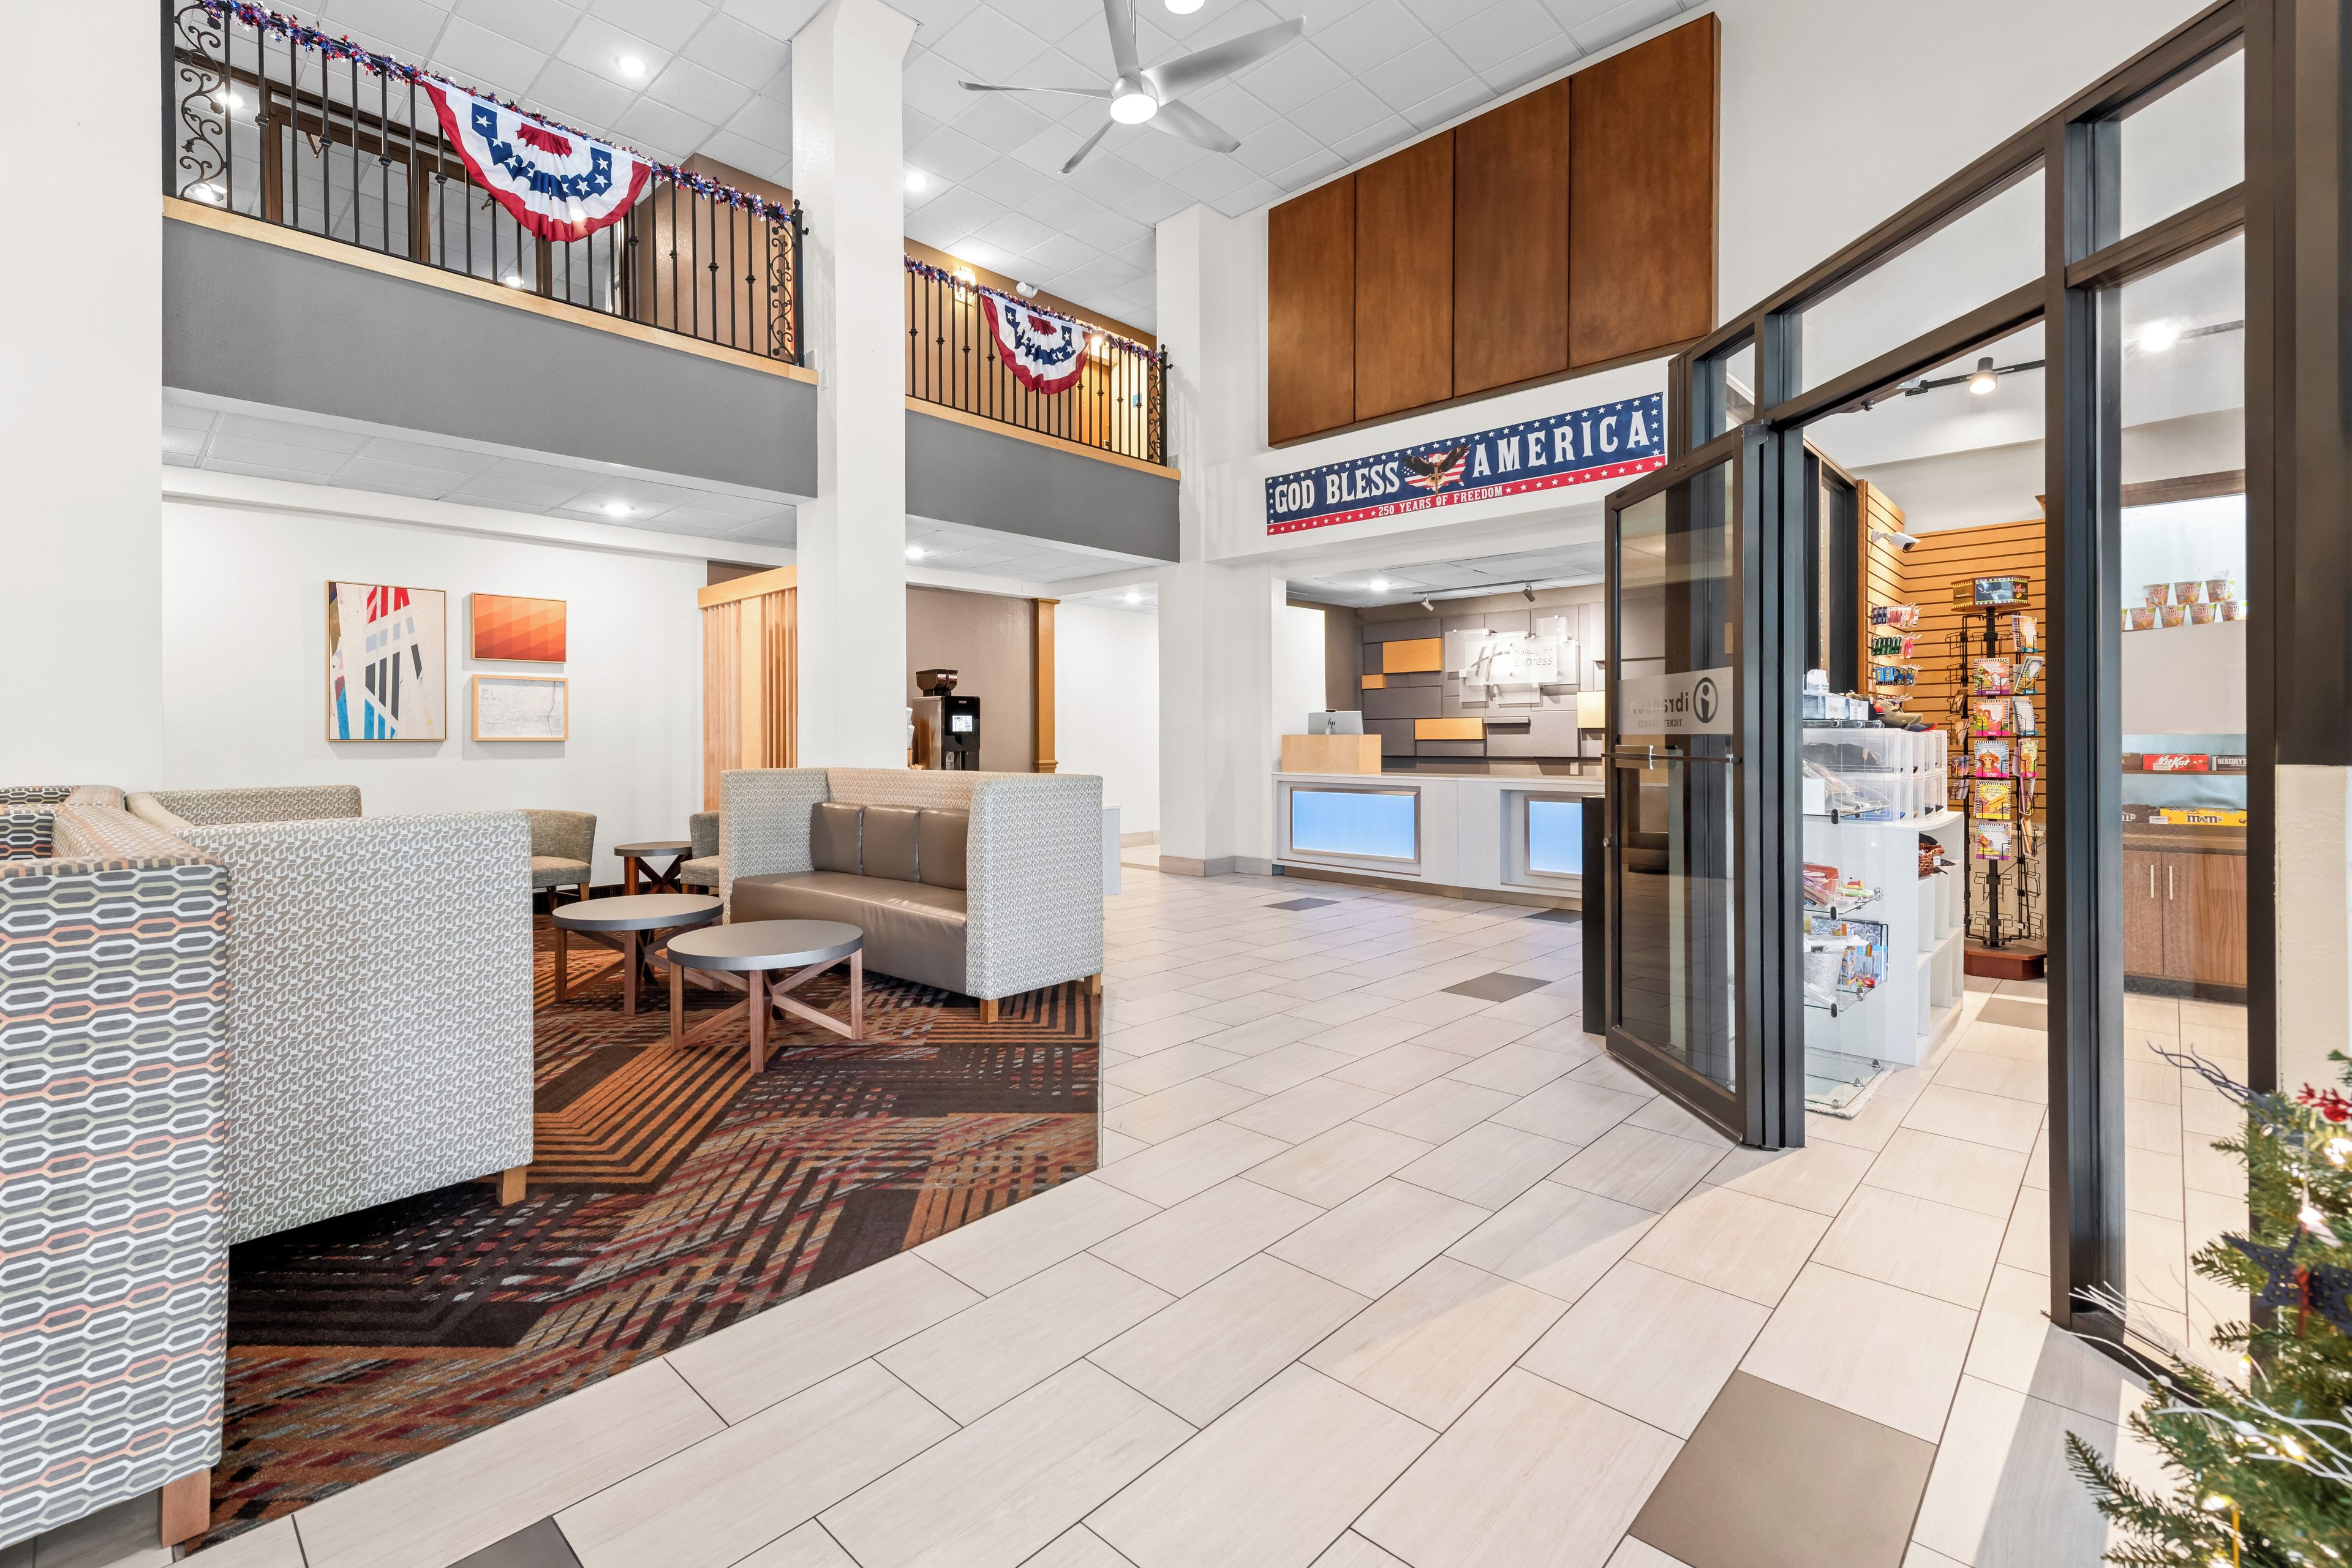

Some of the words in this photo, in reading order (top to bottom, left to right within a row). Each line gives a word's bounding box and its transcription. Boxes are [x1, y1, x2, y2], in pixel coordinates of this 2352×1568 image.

[1275, 479, 1315, 514] GOD
[1326, 461, 1401, 505] BLESS
[1472, 410, 1651, 478] AMERICA
[1378, 504, 1395, 517] 250
[1400, 498, 1433, 513] YEARS
[1436, 495, 1447, 507] OF
[1453, 485, 1502, 504] FREEDOM
[1515, 657, 1553, 667] Express
[1328, 717, 1336, 729] hp
